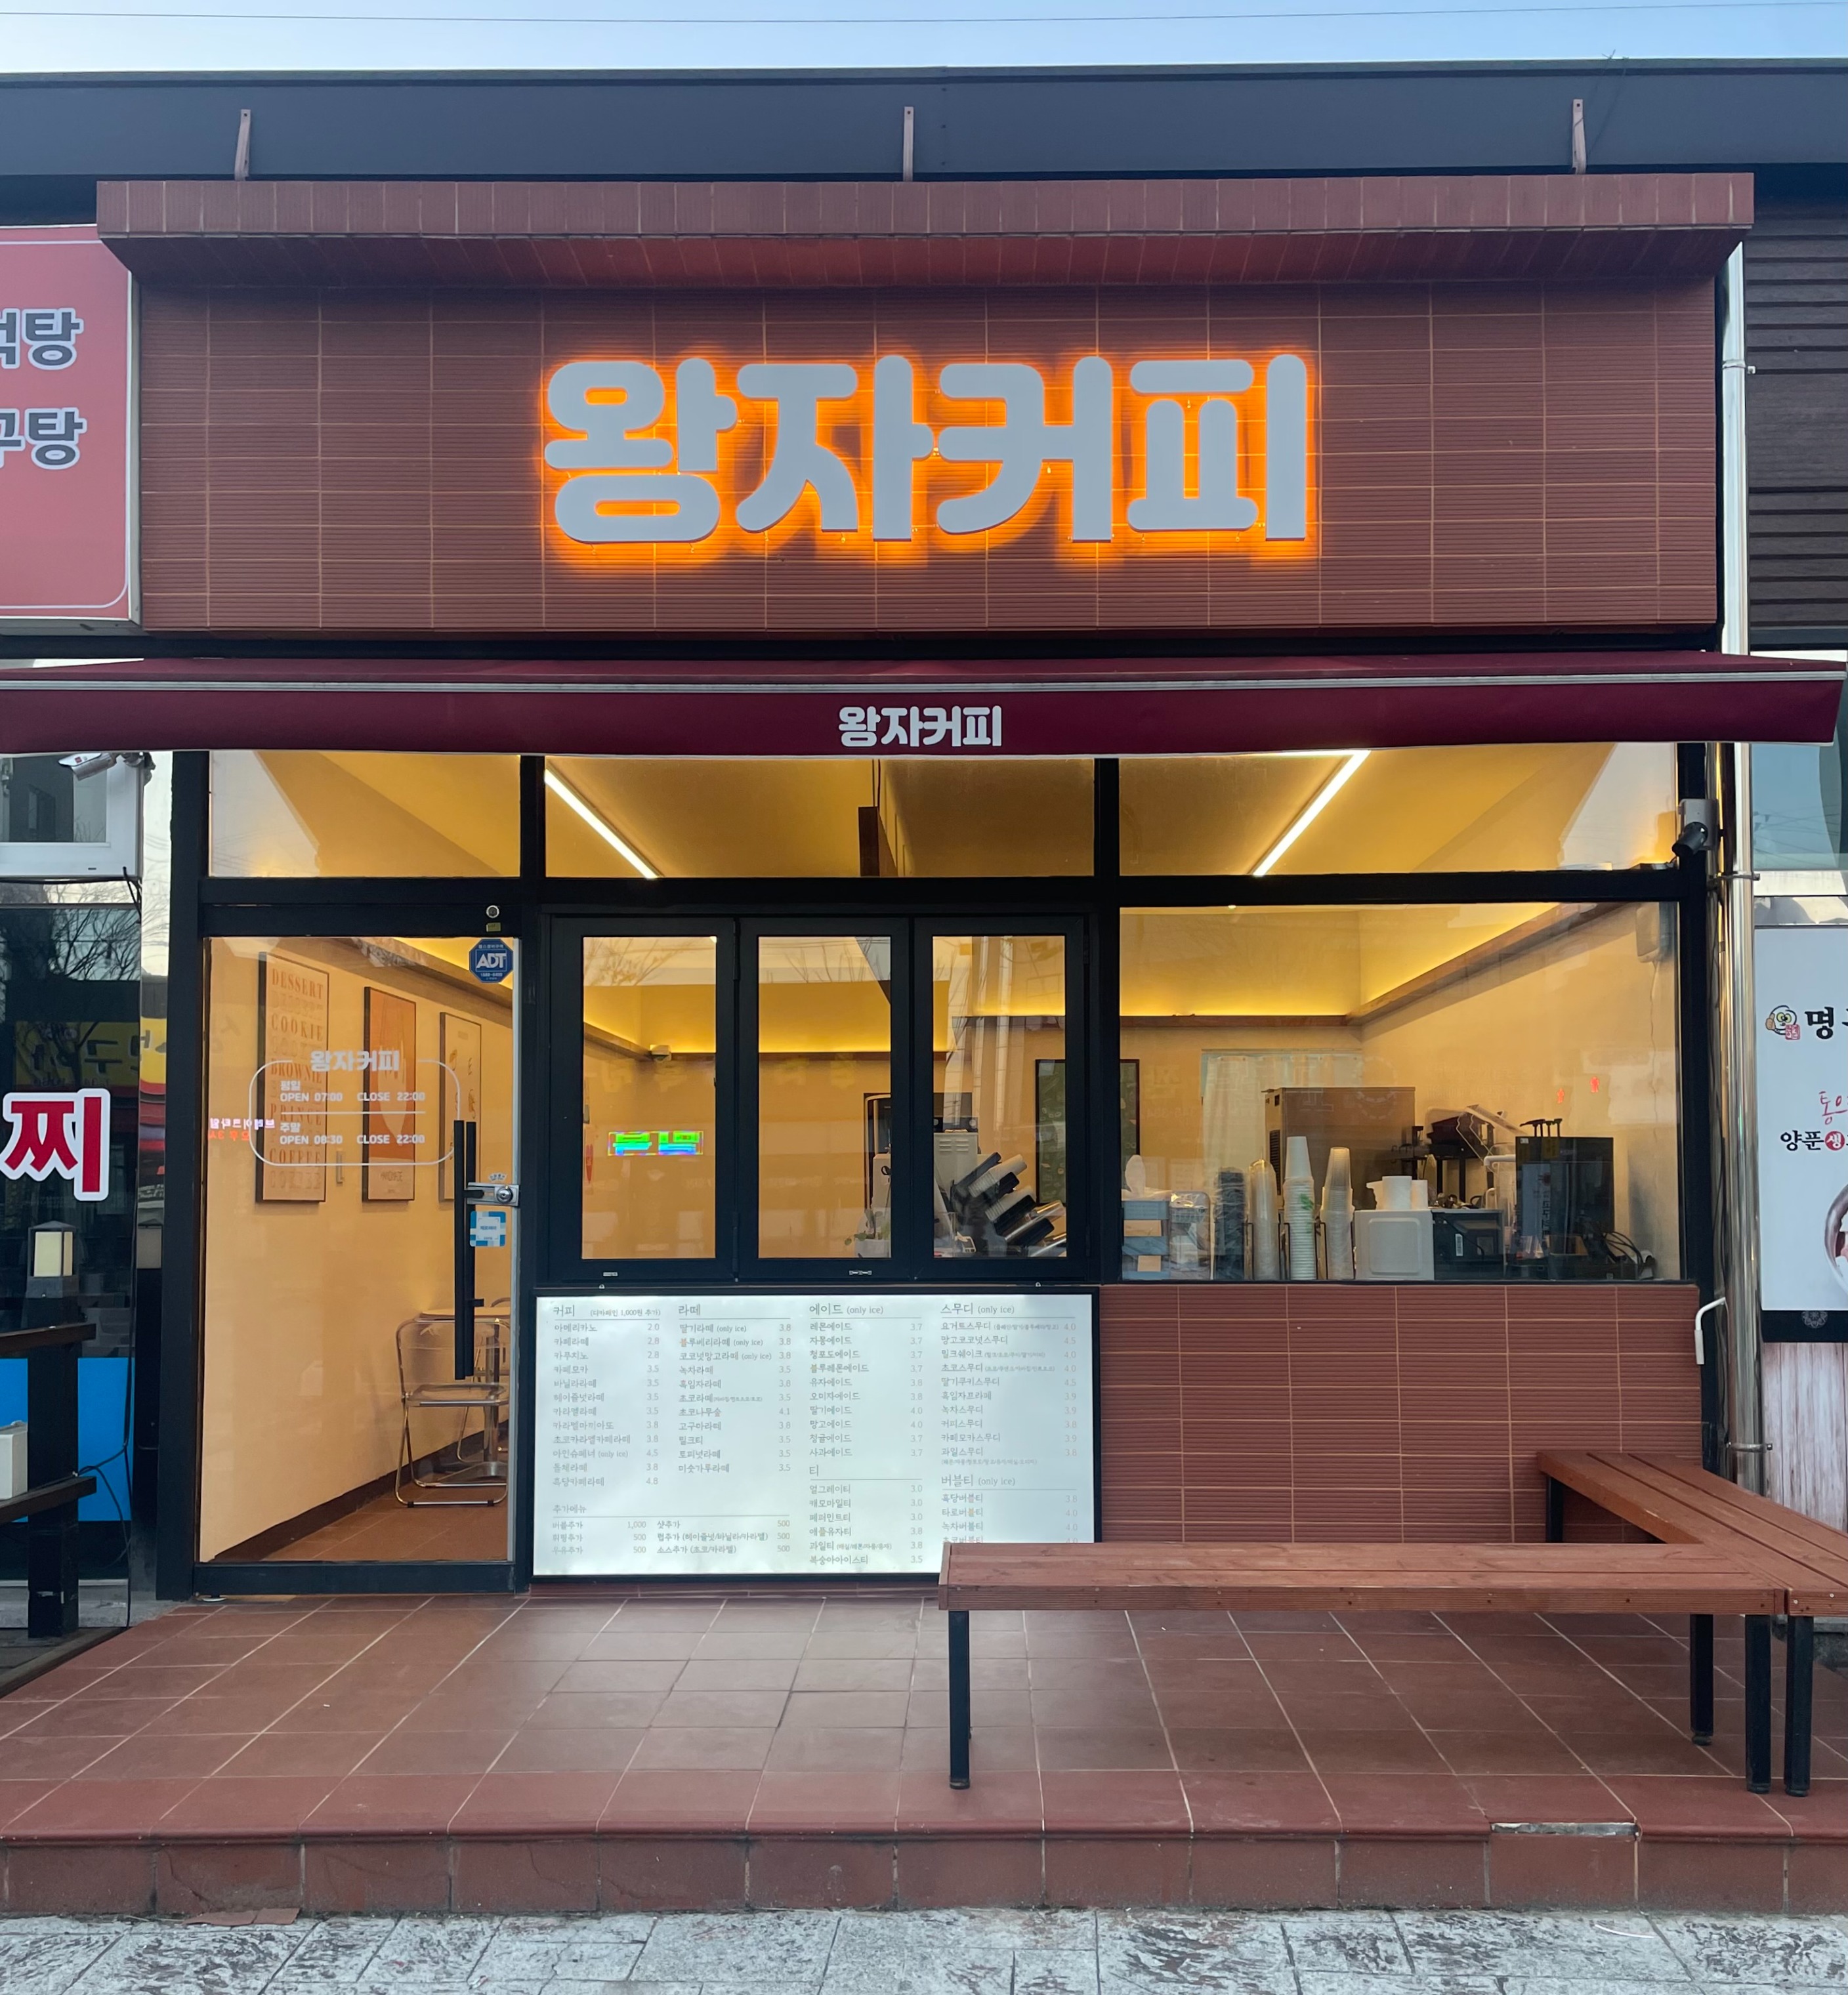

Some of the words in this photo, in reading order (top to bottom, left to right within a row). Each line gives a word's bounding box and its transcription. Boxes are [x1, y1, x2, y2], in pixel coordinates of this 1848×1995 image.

[544, 354, 1308, 543] 왕자커피
[838, 706, 1002, 747] 왕자커피
[476, 953, 507, 969] ADT
[272, 968, 324, 999] DESSERT
[271, 1013, 322, 1041] COOKIE
[310, 1051, 400, 1071] 왕자커피
[280, 1093, 309, 1101] OPEN
[314, 1093, 343, 1101] 07:00
[357, 1092, 390, 1101] CLOSE
[397, 1092, 425, 1101] 22:00
[280, 1122, 300, 1133] 주말
[280, 1135, 308, 1144] OPEN
[314, 1135, 343, 1144] 08:30
[356, 1135, 390, 1144] CLOSE
[396, 1135, 425, 1144] 22:00
[553, 1305, 575, 1317] 커피
[678, 1304, 701, 1316] 라떼
[809, 1303, 843, 1315] 에이드
[847, 1306, 866, 1315] (only
[869, 1306, 884, 1314] ice)
[940, 1303, 973, 1314] 스무디
[978, 1305, 998, 1314] (only
[1000, 1305, 1015, 1314] ice)
[554, 1323, 598, 1332] 아메리카노
[679, 1324, 714, 1334] 딸기라떼
[810, 1322, 852, 1332] 레몬에이드
[941, 1321, 991, 1331] 요거트스무디
[554, 1337, 589, 1346] 카페라떼
[679, 1337, 730, 1347] 블루베리라떼
[809, 1336, 852, 1345] 자몽에이드
[941, 1335, 1008, 1345] 망고코코넛스무디
[554, 1351, 589, 1360] 카푸치노
[679, 1352, 738, 1361] 코코넛망고라떼
[809, 1349, 860, 1360] 청포도에이드
[941, 1349, 983, 1359] 밀크쉐이크
[554, 1365, 588, 1374] 카페모카
[679, 1366, 713, 1375] 녹차라떼
[810, 1364, 870, 1373] 블루레몬에이드
[940, 1363, 983, 1372] 초코스무디
[554, 1379, 597, 1388] 바닐라라떼
[679, 1379, 721, 1389] 흑임자라떼
[810, 1377, 852, 1387] 유자에이드
[940, 1377, 999, 1387] 딸기쿠키스무디
[679, 1393, 713, 1402] 초코라떼
[809, 1391, 860, 1401] 오미자에이드
[553, 1407, 597, 1416] 카라멜라떼
[679, 1407, 722, 1417] 초코나무숲
[809, 1406, 852, 1416] 딸기에이드
[941, 1405, 983, 1414] 녹차스무디
[553, 1421, 614, 1431] 카라멜마끼아또
[679, 1421, 722, 1431] 고구마라떼
[810, 1419, 852, 1429] 망고에이드
[940, 1419, 982, 1428] 커피스무디
[679, 1435, 704, 1445] 밀크티
[940, 1433, 1001, 1442] 카페모카스무디
[553, 1449, 595, 1459] 아인슈페너
[598, 1450, 614, 1459] (only
[679, 1450, 721, 1459] 토피넛라떼
[809, 1448, 852, 1457] 사과에이드
[941, 1447, 983, 1457] 과일스무디
[679, 1463, 730, 1473] 미숫가루라떼
[809, 1465, 819, 1477] 티
[553, 1477, 604, 1487] 흑당카페라떼
[941, 1474, 974, 1486] 버블티
[978, 1477, 998, 1486] (only
[1001, 1477, 1016, 1486] ice)
[809, 1484, 850, 1494] 얼그레이티
[809, 1498, 851, 1508] 캐모마일티
[941, 1493, 983, 1503] 흑당버블티
[553, 1504, 587, 1514] 추가메뉴
[942, 1507, 983, 1517] 타로버블티
[657, 1520, 681, 1529] 샷추가
[942, 1521, 983, 1532] 녹차버블티
[809, 1541, 834, 1551] 과일티
